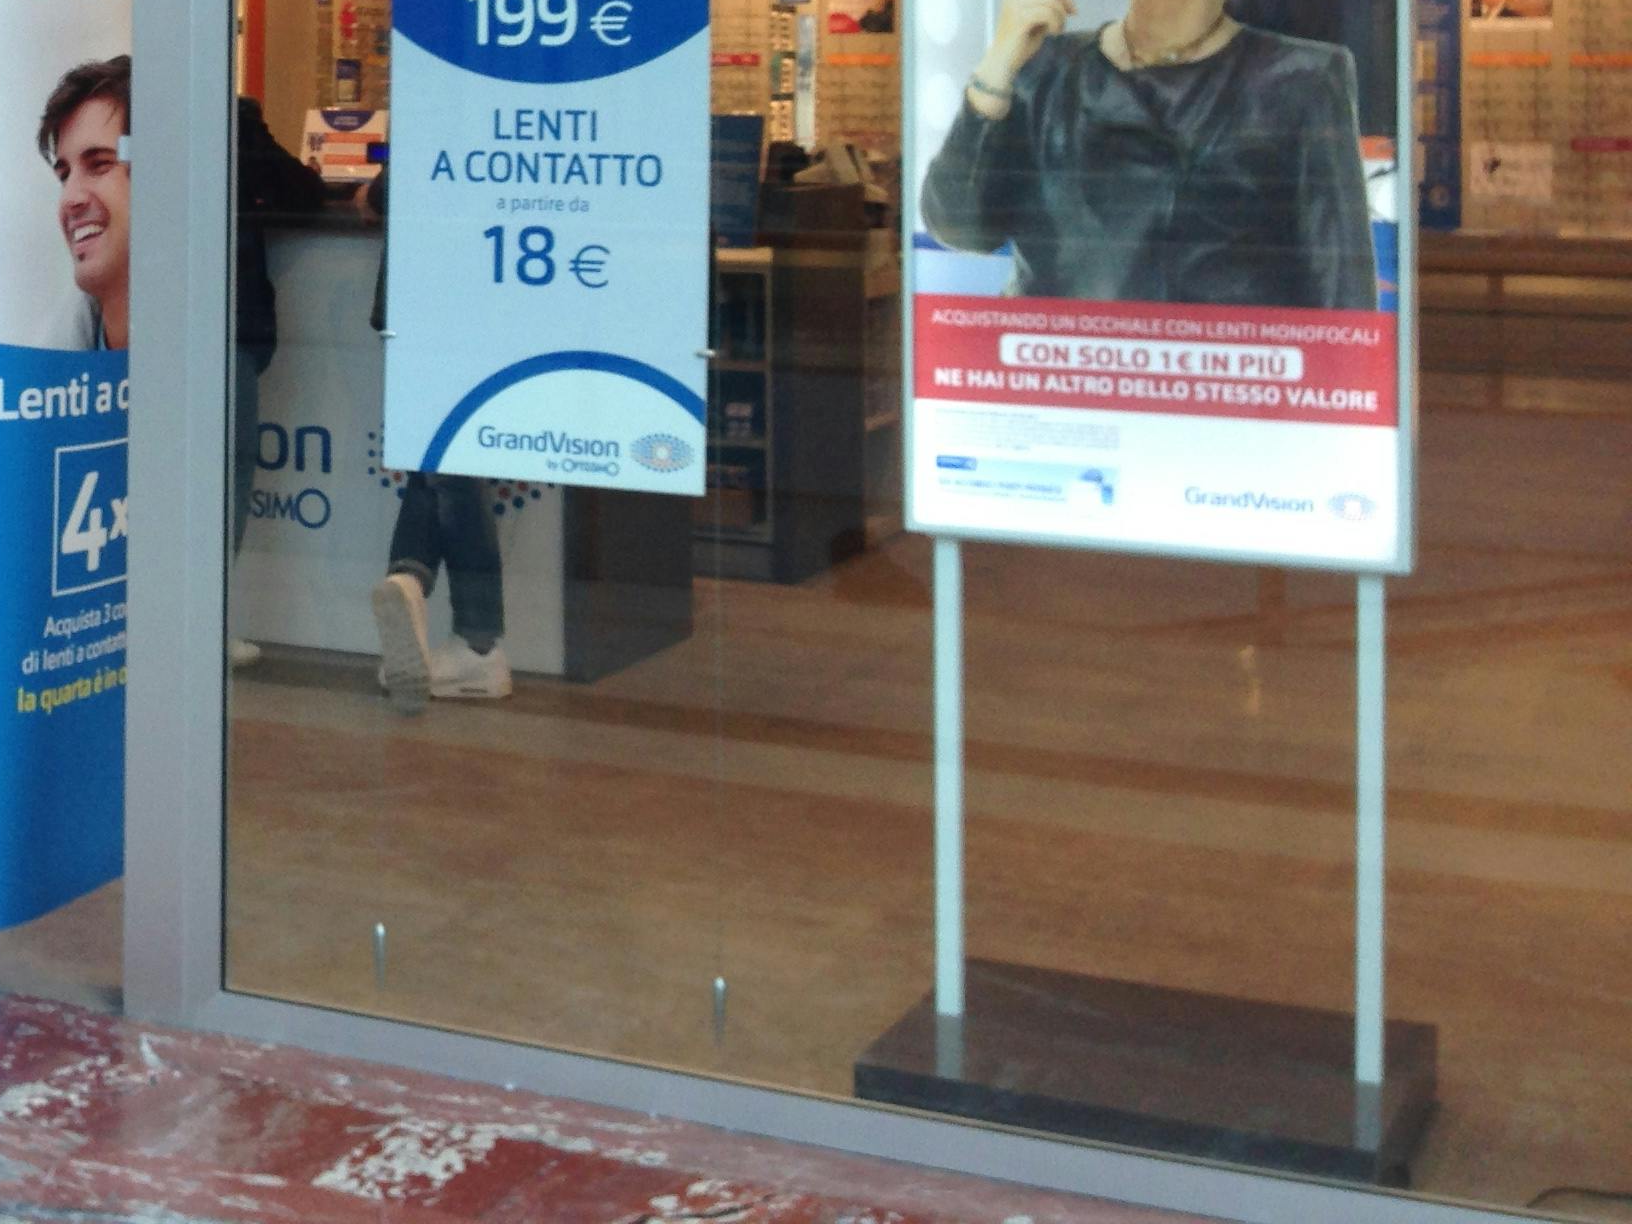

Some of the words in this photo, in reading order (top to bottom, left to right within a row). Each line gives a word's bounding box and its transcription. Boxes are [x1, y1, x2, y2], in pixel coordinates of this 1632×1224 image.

[590, 0, 634, 46] €
[493, 109, 598, 142] LENTI
[430, 150, 456, 182] A
[465, 151, 664, 188] CONTATTO
[496, 196, 506, 211] a
[510, 193, 566, 214] partire
[569, 196, 590, 213] da
[483, 225, 557, 287] 18
[569, 245, 612, 289] €
[932, 308, 1047, 330] ACQUISTANDO
[1050, 313, 1075, 330] UN
[1078, 315, 1162, 335] OCCHIALE
[1164, 318, 1201, 337] CON
[1207, 320, 1256, 339] LENTI
[1260, 322, 1381, 346] MONOFOCALI
[1018, 343, 1070, 364] CON
[1077, 345, 1151, 369] SOLO
[1200, 352, 1230, 374] IN
[1239, 348, 1287, 376] PIÙ
[95, 381, 112, 413] a
[934, 367, 963, 387] NE
[967, 370, 1005, 389] HAI
[1008, 373, 1041, 391] UN
[1044, 375, 1114, 394] ALTRO
[1119, 378, 1189, 401] DELLO
[1194, 382, 1281, 406] STESSO
[1286, 387, 1379, 411] VALORE
[478, 426, 620, 458] GrandVision
[1184, 486, 1315, 513] GrandVision
[44, 609, 102, 639] Acquista
[103, 603, 112, 624] 3
[22, 650, 40, 675] di
[43, 644, 74, 672] lenti
[76, 646, 85, 663] a
[17, 687, 37, 713] la
[40, 677, 91, 714] quarta
[94, 668, 104, 693] è
[104, 666, 118, 690] in
